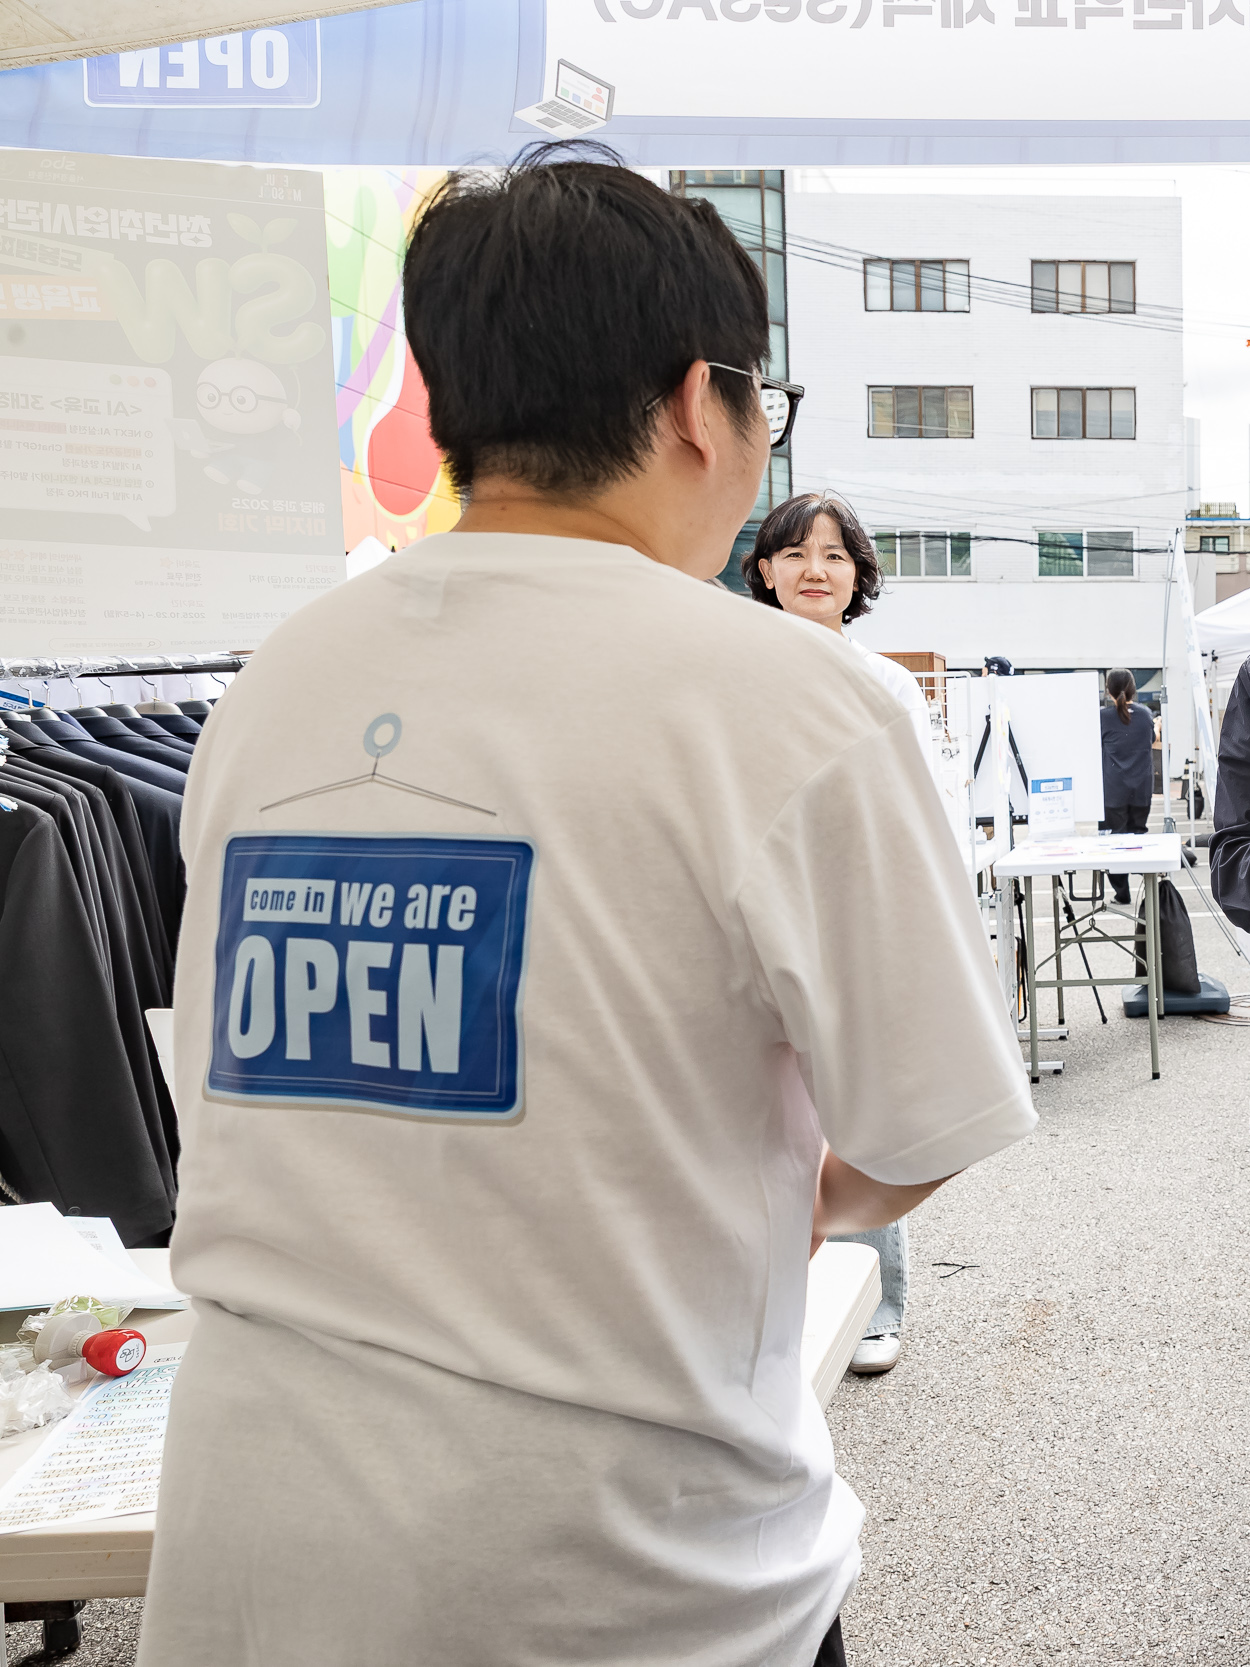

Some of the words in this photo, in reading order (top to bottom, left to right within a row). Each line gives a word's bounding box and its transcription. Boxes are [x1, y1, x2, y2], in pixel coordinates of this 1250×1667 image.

[249, 888, 296, 912] come
[303, 885, 326, 914] in
[339, 881, 396, 929] we
[403, 883, 478, 932] are
[227, 934, 465, 1074] OPEN
